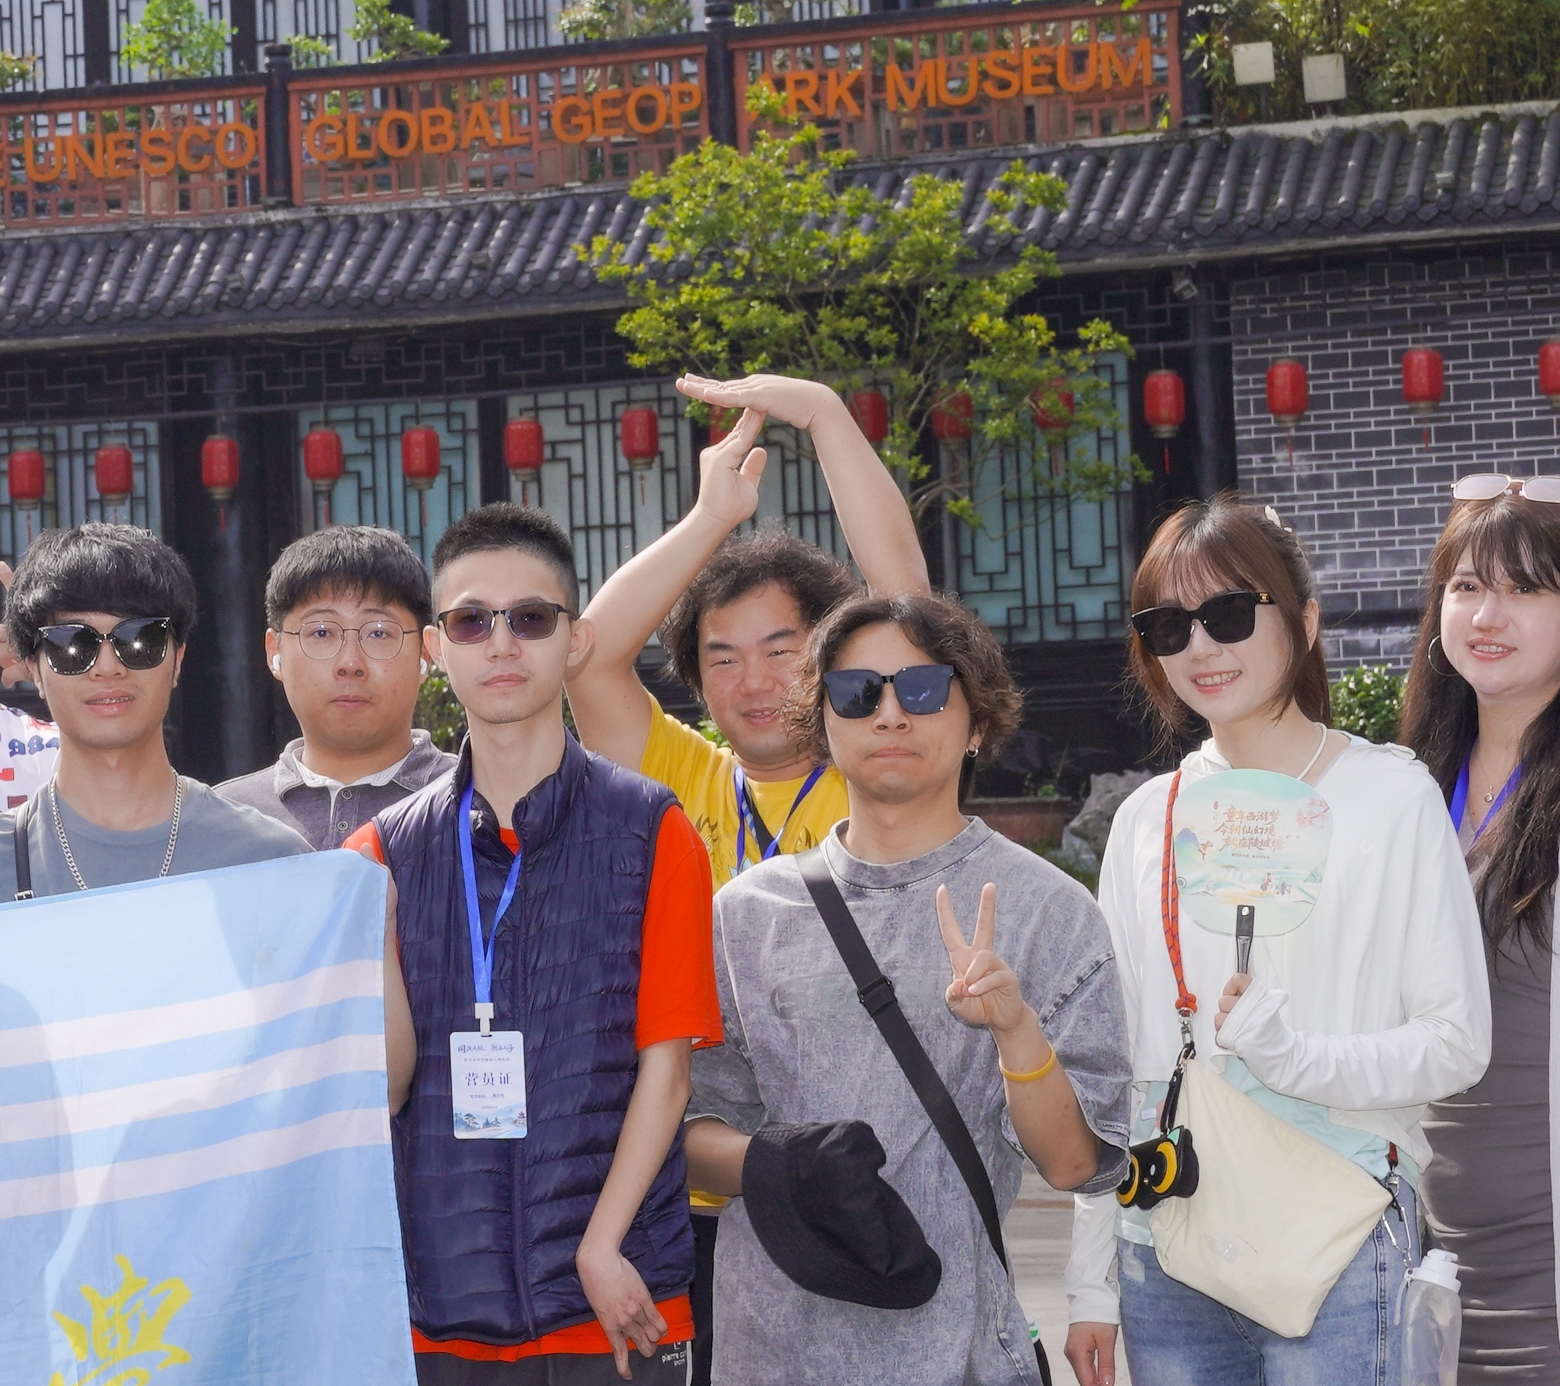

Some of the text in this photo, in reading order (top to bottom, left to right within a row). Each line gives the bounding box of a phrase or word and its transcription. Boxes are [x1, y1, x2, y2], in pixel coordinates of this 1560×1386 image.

[24, 121, 258, 183] UNESCO
[305, 99, 531, 164] GLOBAL
[885, 37, 1153, 112] MUSEUM
[465, 1071, 513, 1087] 营员证
